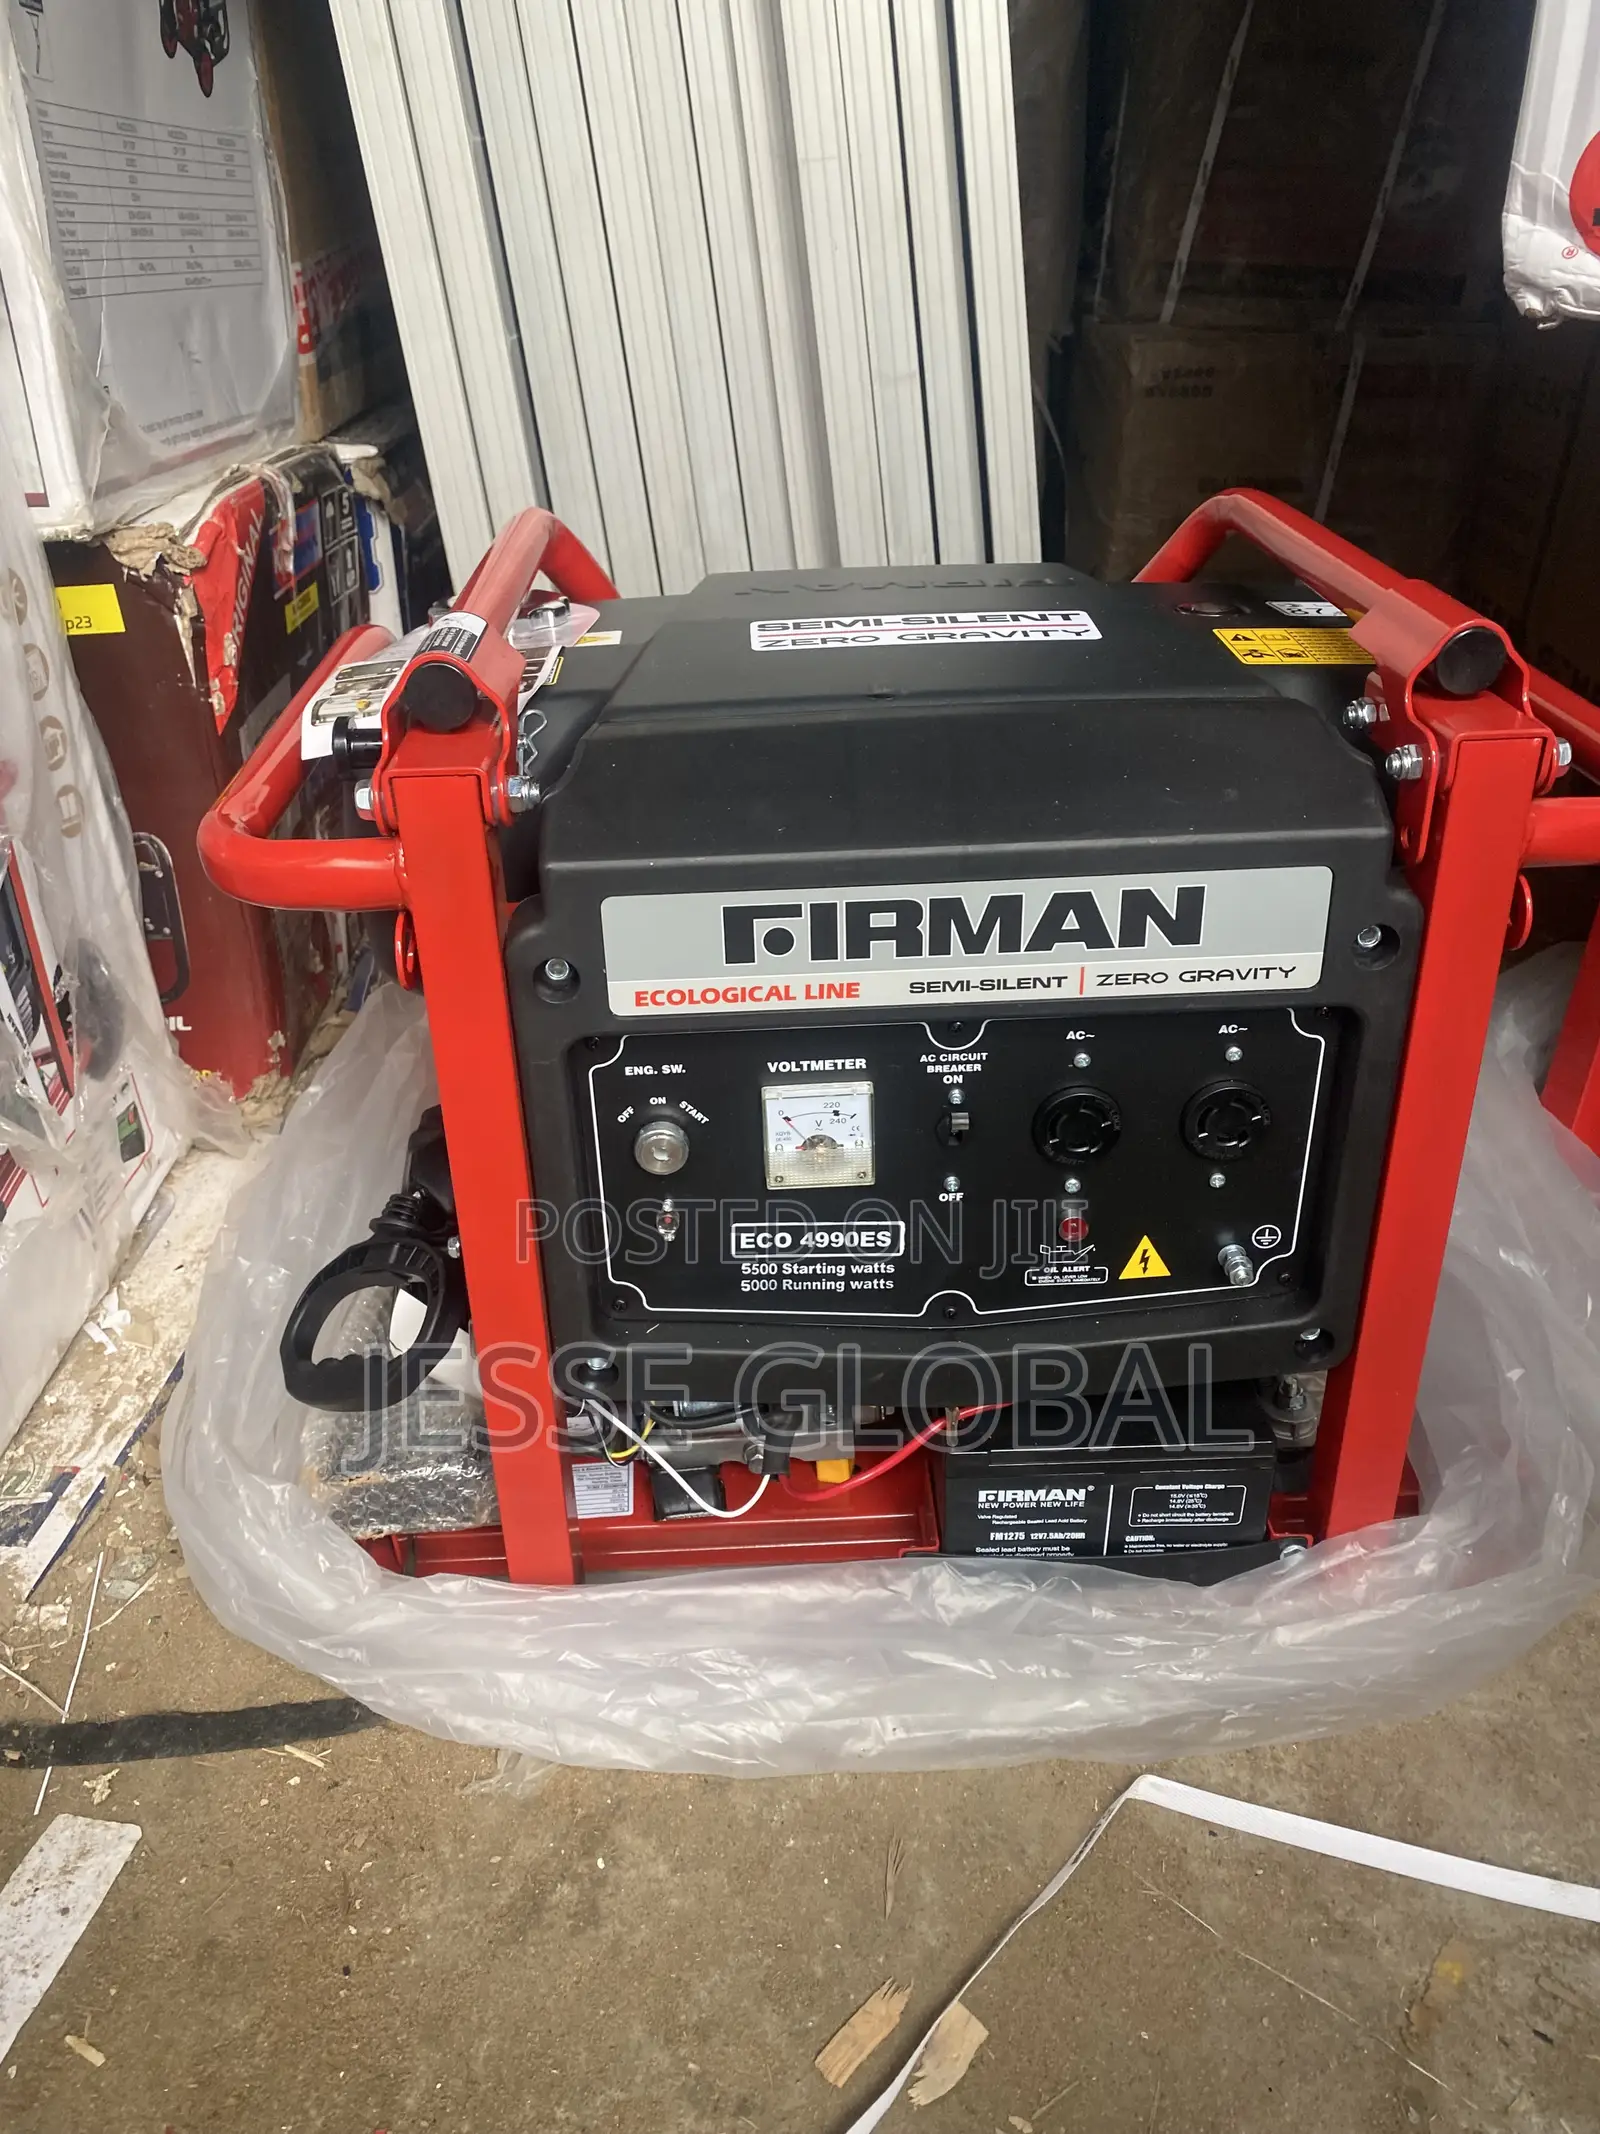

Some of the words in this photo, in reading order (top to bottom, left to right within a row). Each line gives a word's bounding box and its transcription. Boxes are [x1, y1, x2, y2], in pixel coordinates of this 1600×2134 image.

[231, 508, 264, 650] RIGINAL
[756, 611, 1080, 632] SEMI-SILENT
[760, 635, 879, 648] ZERO
[897, 628, 1091, 642] GRAVITY
[720, 884, 1207, 966] FIRMAN
[1096, 971, 1169, 986] ZERO
[1178, 965, 1297, 984] GRAVITY
[908, 974, 1068, 994] SEMI-SILENT
[634, 983, 796, 1008] ECOLOGICAL
[805, 982, 860, 1000] LINE
[767, 1058, 867, 1073] VOLTMETER
[920, 1054, 937, 1064] AC
[940, 1052, 988, 1062] CIRCUIT
[624, 1066, 658, 1076] ENG.
[661, 1064, 686, 1075] SW.
[926, 1063, 982, 1073] BREAKER
[943, 1074, 964, 1084] ON
[649, 1096, 667, 1106] ON
[616, 1105, 636, 1124] OFF
[678, 1100, 710, 1126] START
[938, 1192, 964, 1202] OFF
[740, 1232, 792, 1248] ECO
[800, 1231, 892, 1248] 4990ES
[741, 1263, 778, 1275] 5500
[782, 1262, 846, 1276] Starting
[850, 1262, 896, 1274] watts
[740, 1279, 778, 1292] 5000
[782, 1278, 846, 1292] Running
[850, 1278, 894, 1290] watts
[990, 1532, 1025, 1541] FM1275
